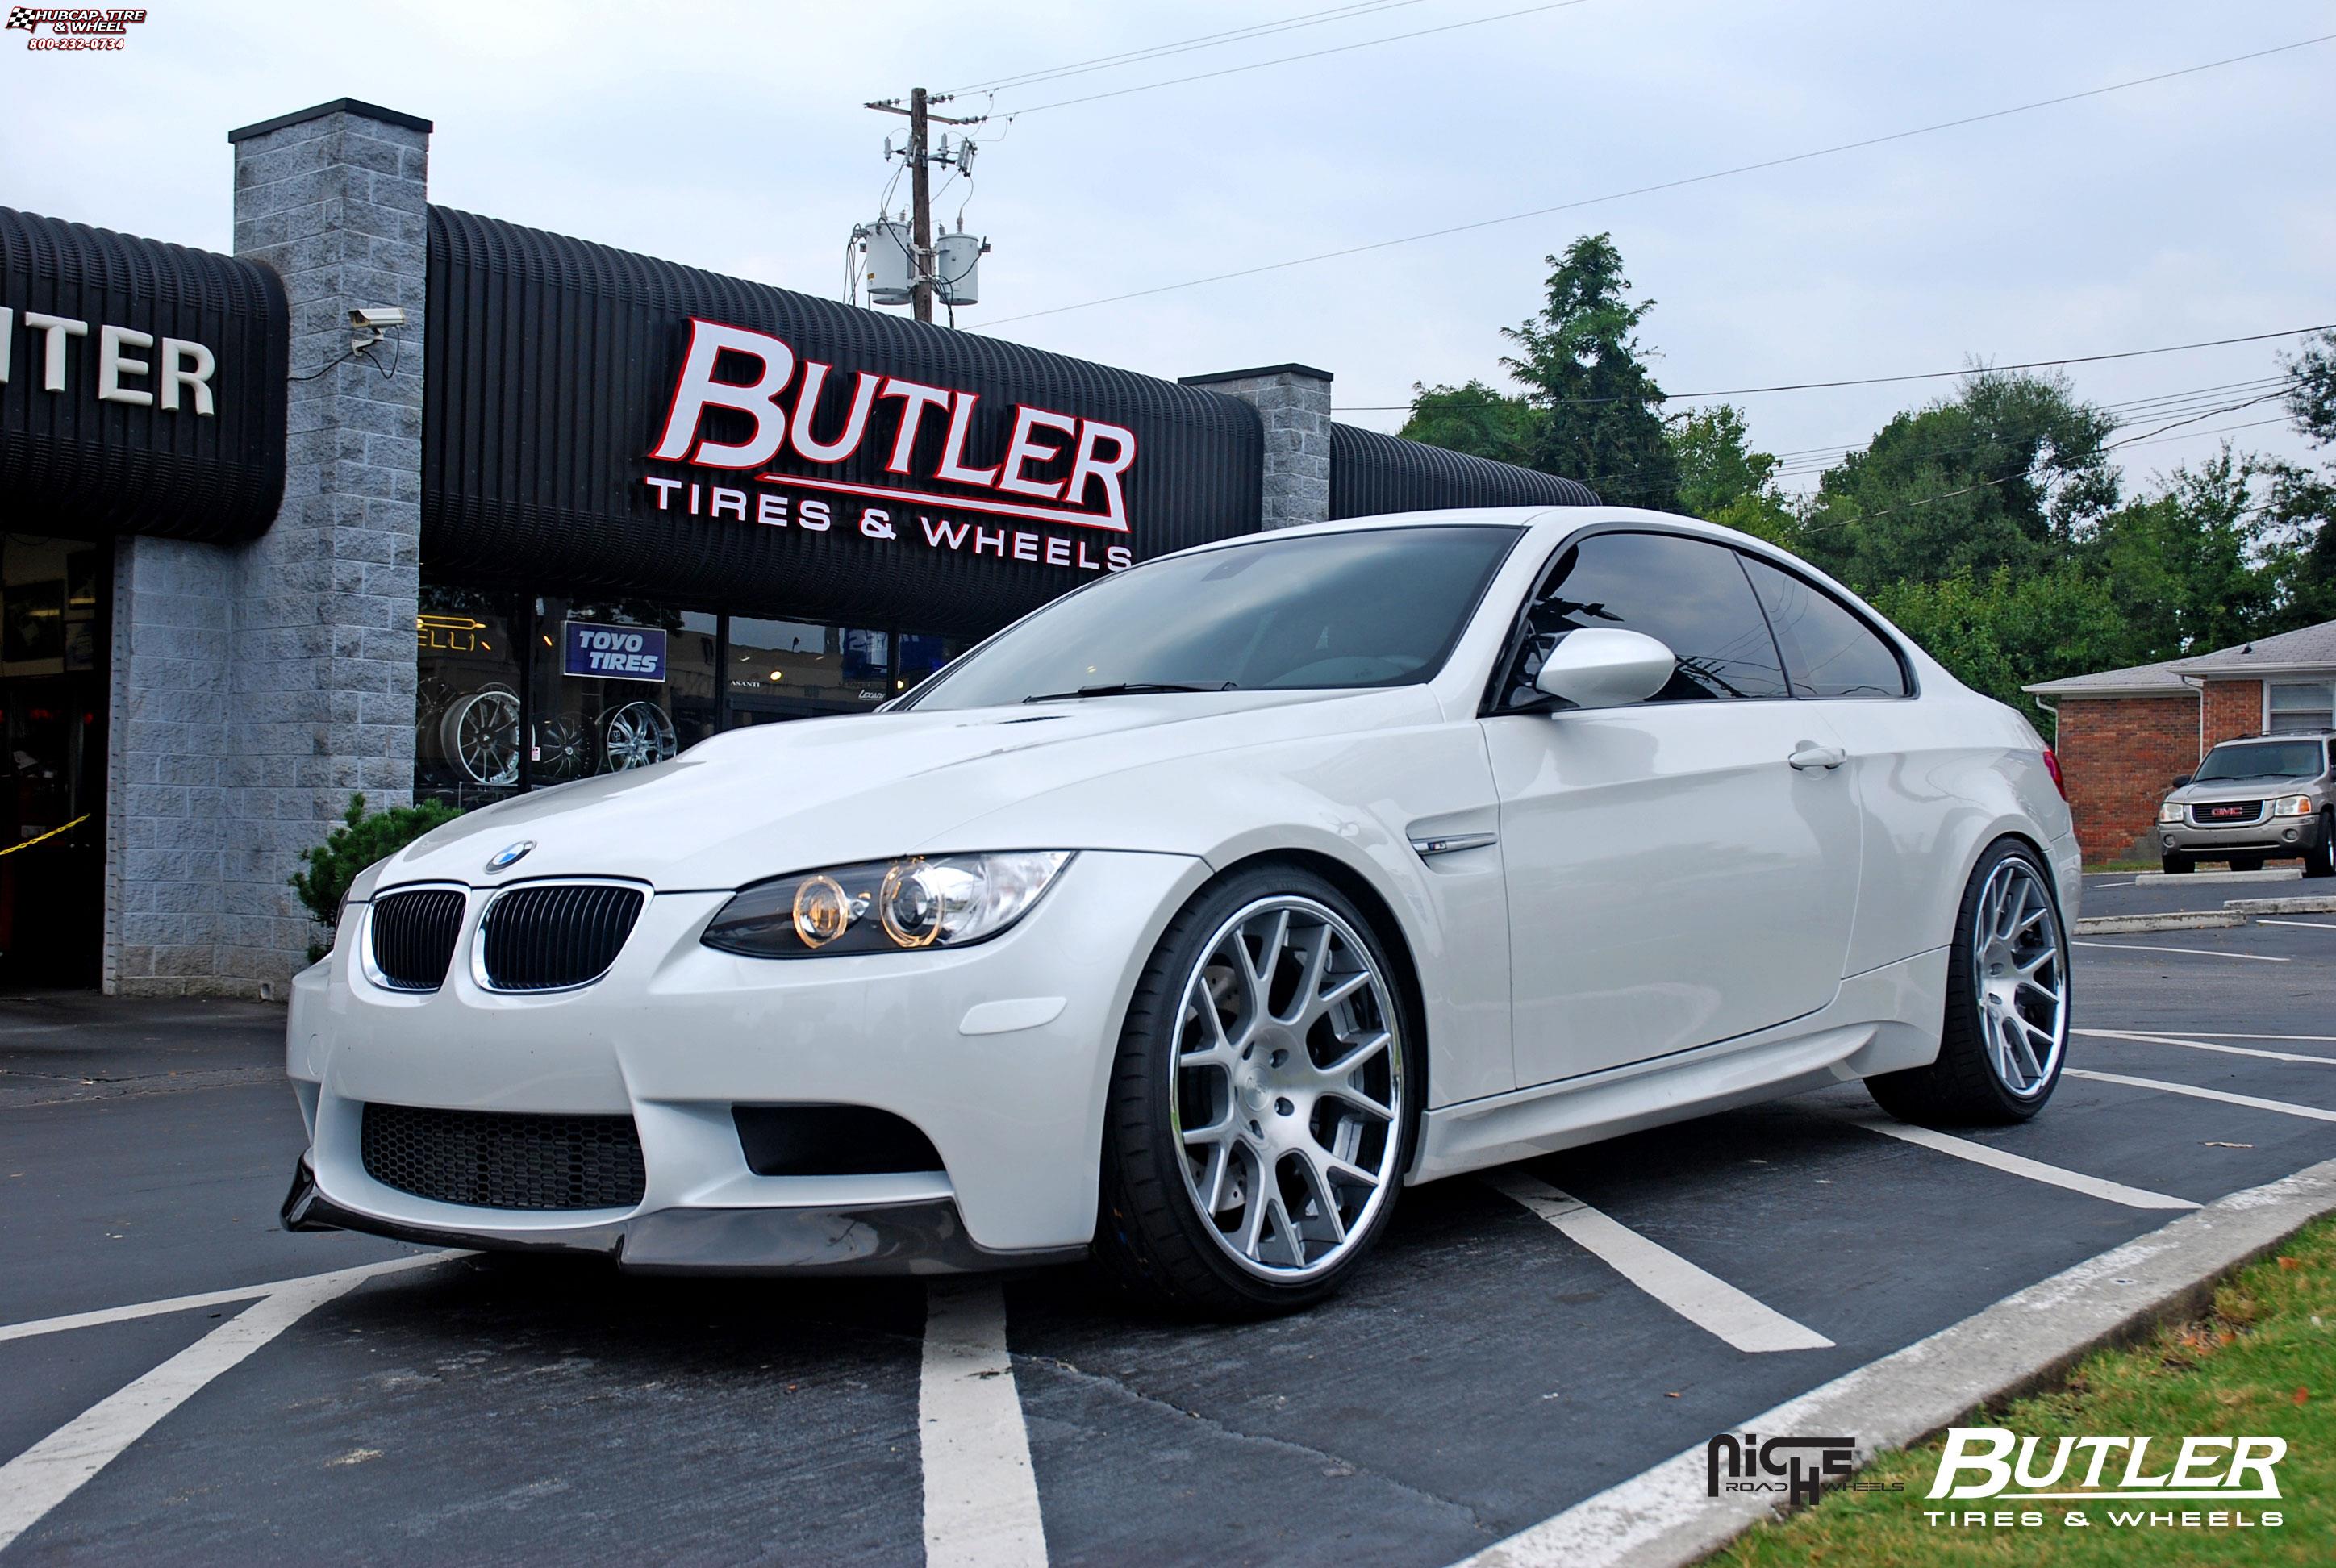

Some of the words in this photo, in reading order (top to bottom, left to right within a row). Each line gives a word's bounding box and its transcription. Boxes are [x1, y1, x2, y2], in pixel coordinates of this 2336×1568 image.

[649, 317, 1137, 533] BUTLER
[645, 477, 832, 532] TIRES
[860, 508, 897, 540] &
[919, 516, 1133, 573] WHEELS
[579, 630, 644, 653] TOYO
[590, 651, 658, 673] TIRES
[2211, 807, 2242, 816] GMC
